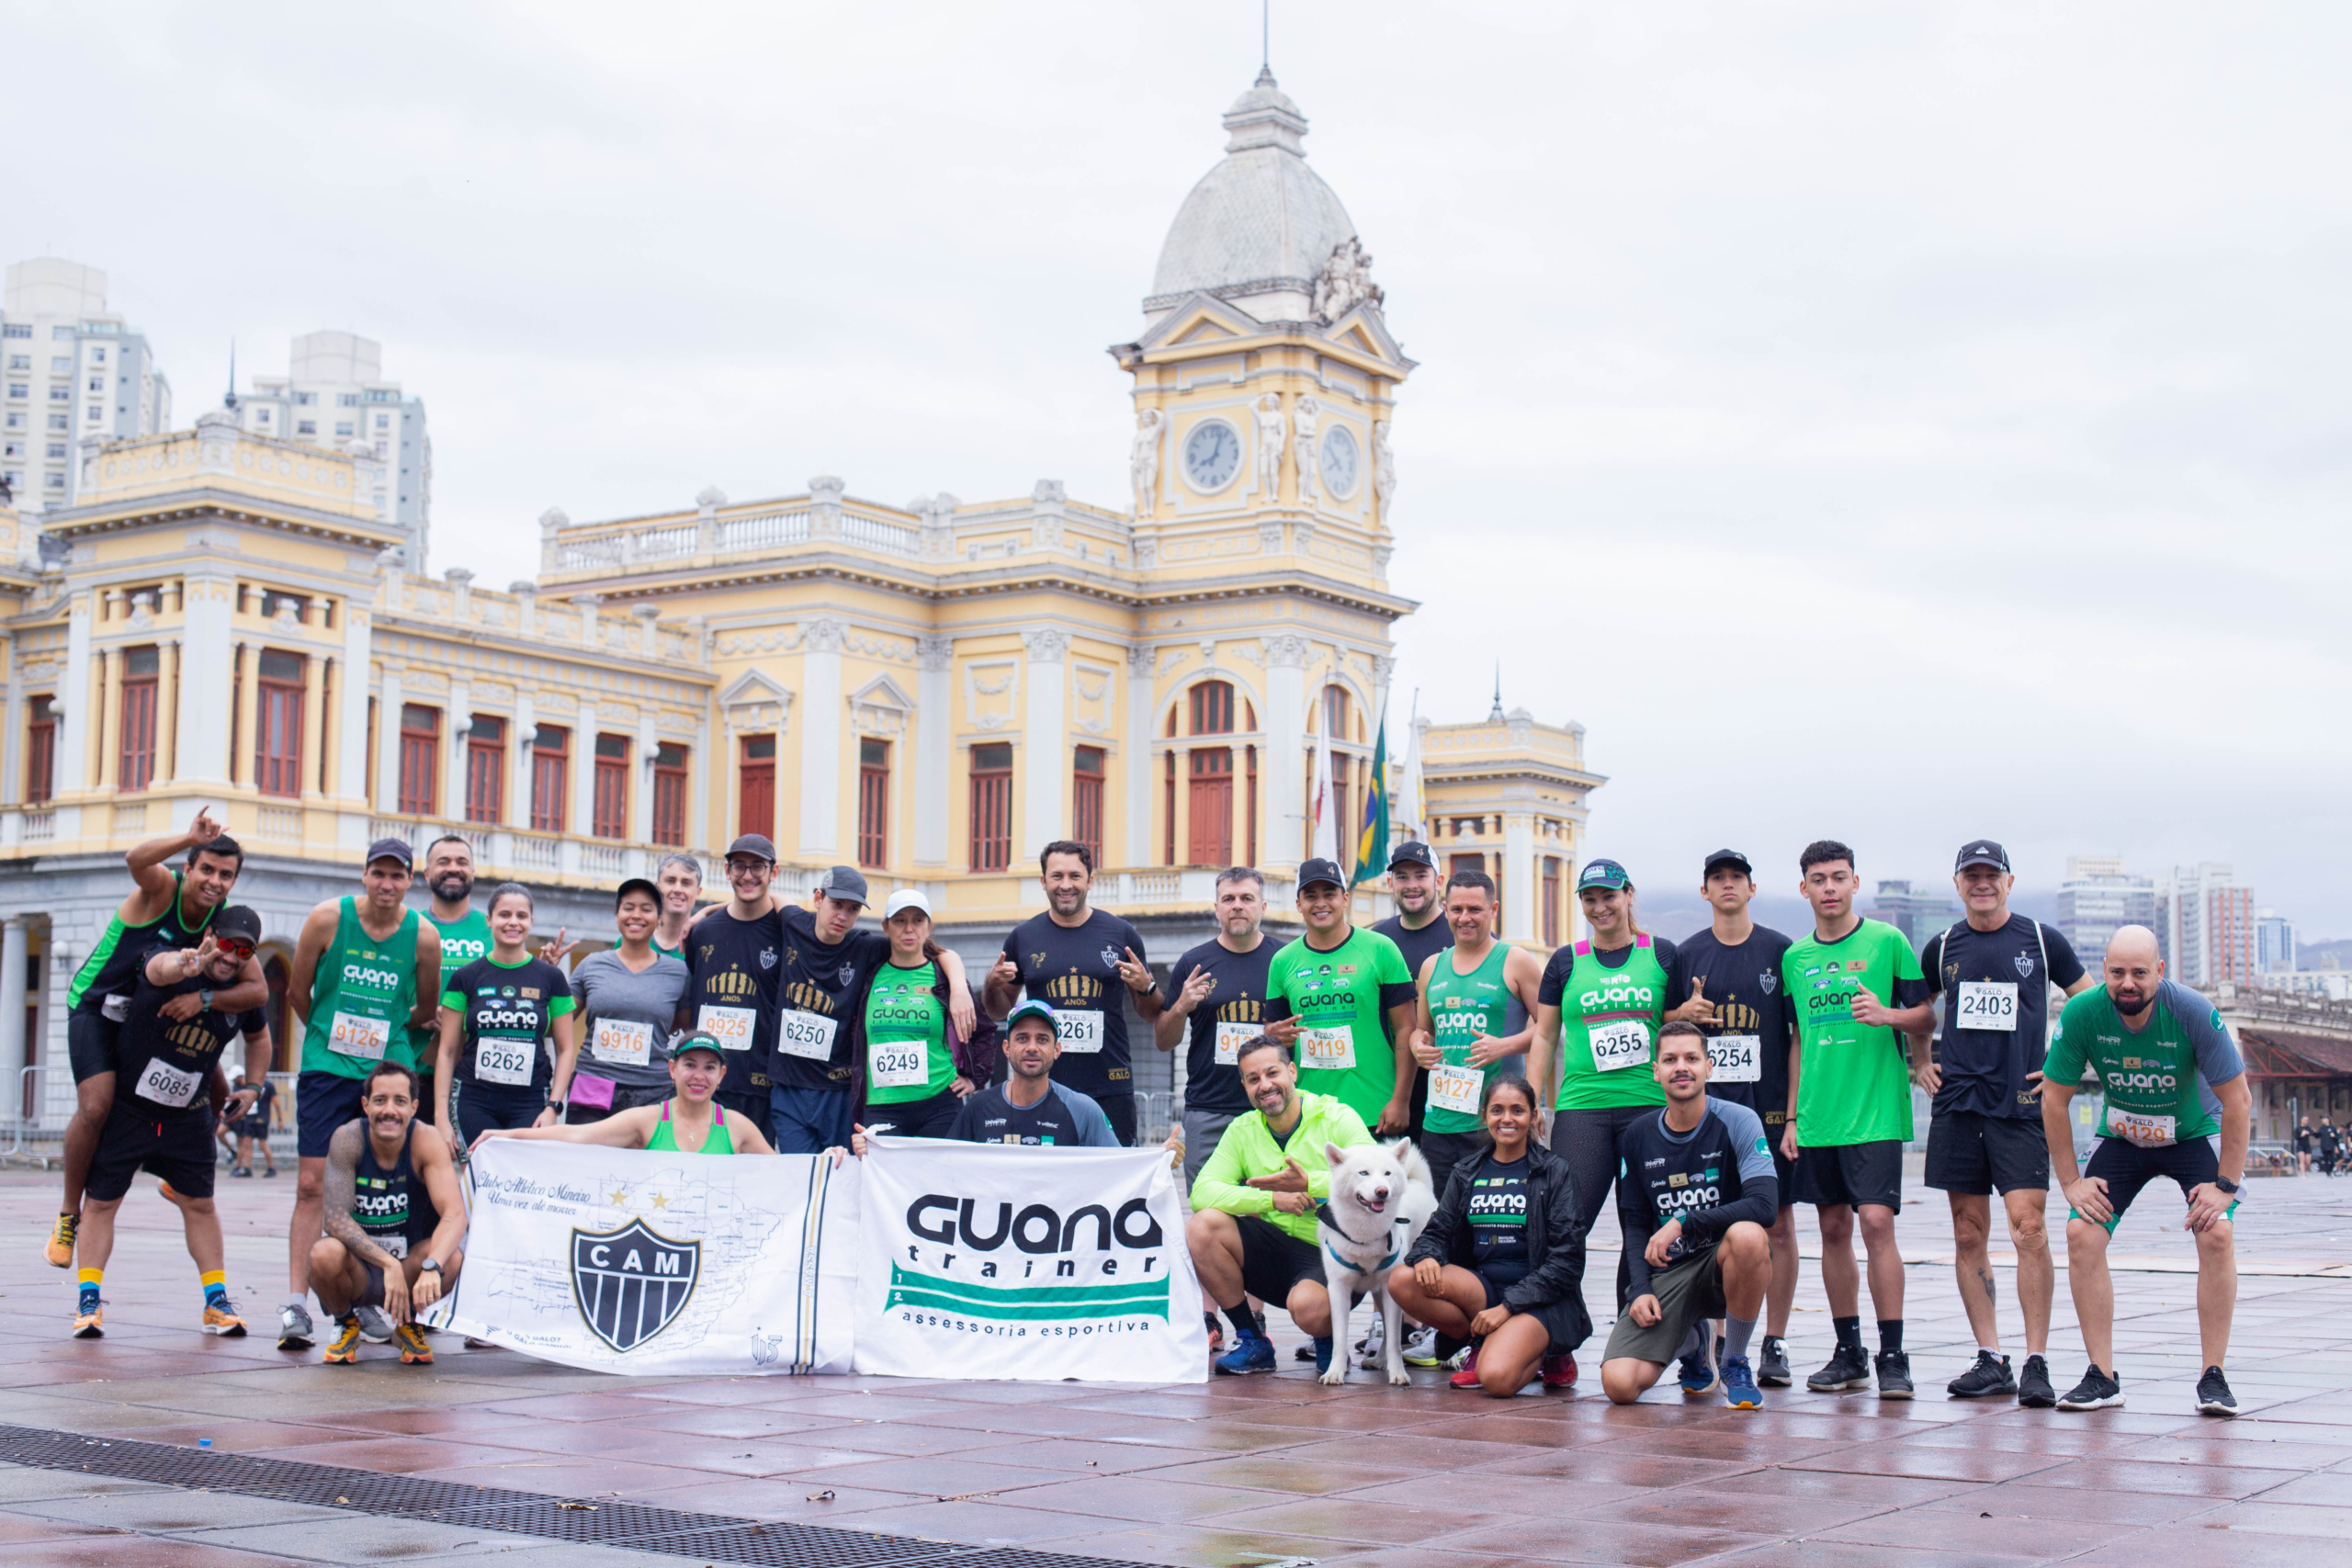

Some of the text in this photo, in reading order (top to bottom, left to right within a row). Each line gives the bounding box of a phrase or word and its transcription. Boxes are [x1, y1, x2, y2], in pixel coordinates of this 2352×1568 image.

[720, 995, 741, 1003] ANOS
[1580, 987, 1652, 1007] Guana
[1962, 996, 2012, 1015] 2403
[1582, 1001, 1651, 1014] trainer
[1810, 1006, 1845, 1015] train
[334, 1024, 379, 1047] 9126
[706, 1017, 747, 1037] 9925
[786, 1022, 825, 1045] 6250
[600, 1030, 643, 1052] 9916
[1220, 1034, 1252, 1052] 91
[1307, 1039, 1346, 1056] 9119
[1596, 1032, 1642, 1056] 6255
[2097, 1034, 2120, 1043] Universo
[481, 1051, 525, 1072] 6262
[876, 1054, 919, 1073] 6249
[1708, 1048, 1752, 1067] 6254
[149, 1071, 190, 1097] 6085
[1108, 1072, 1130, 1080] GALO
[2107, 1072, 2177, 1088] Guana
[1434, 1076, 1474, 1099] 9127
[2109, 1084, 2176, 1094] trainer
[1766, 1115, 1785, 1124] GAL
[2115, 1122, 2165, 1142] 9129
[477, 1170, 591, 1203] Clube Atlético Mineiro
[1471, 1193, 1527, 1208] Guana
[1657, 1186, 1720, 1209] Guana
[514, 1201, 529, 1210] vez
[531, 1199, 546, 1212] até
[547, 1204, 577, 1216] morrer
[906, 1194, 1163, 1254] Guana
[590, 1245, 680, 1275] CAM
[908, 1245, 1157, 1278] trainer
[803, 1246, 816, 1299] A MASSA
[896, 1273, 902, 1283] 1
[894, 1292, 903, 1302] 2
[902, 1311, 1149, 1338] assessoria esportiva
